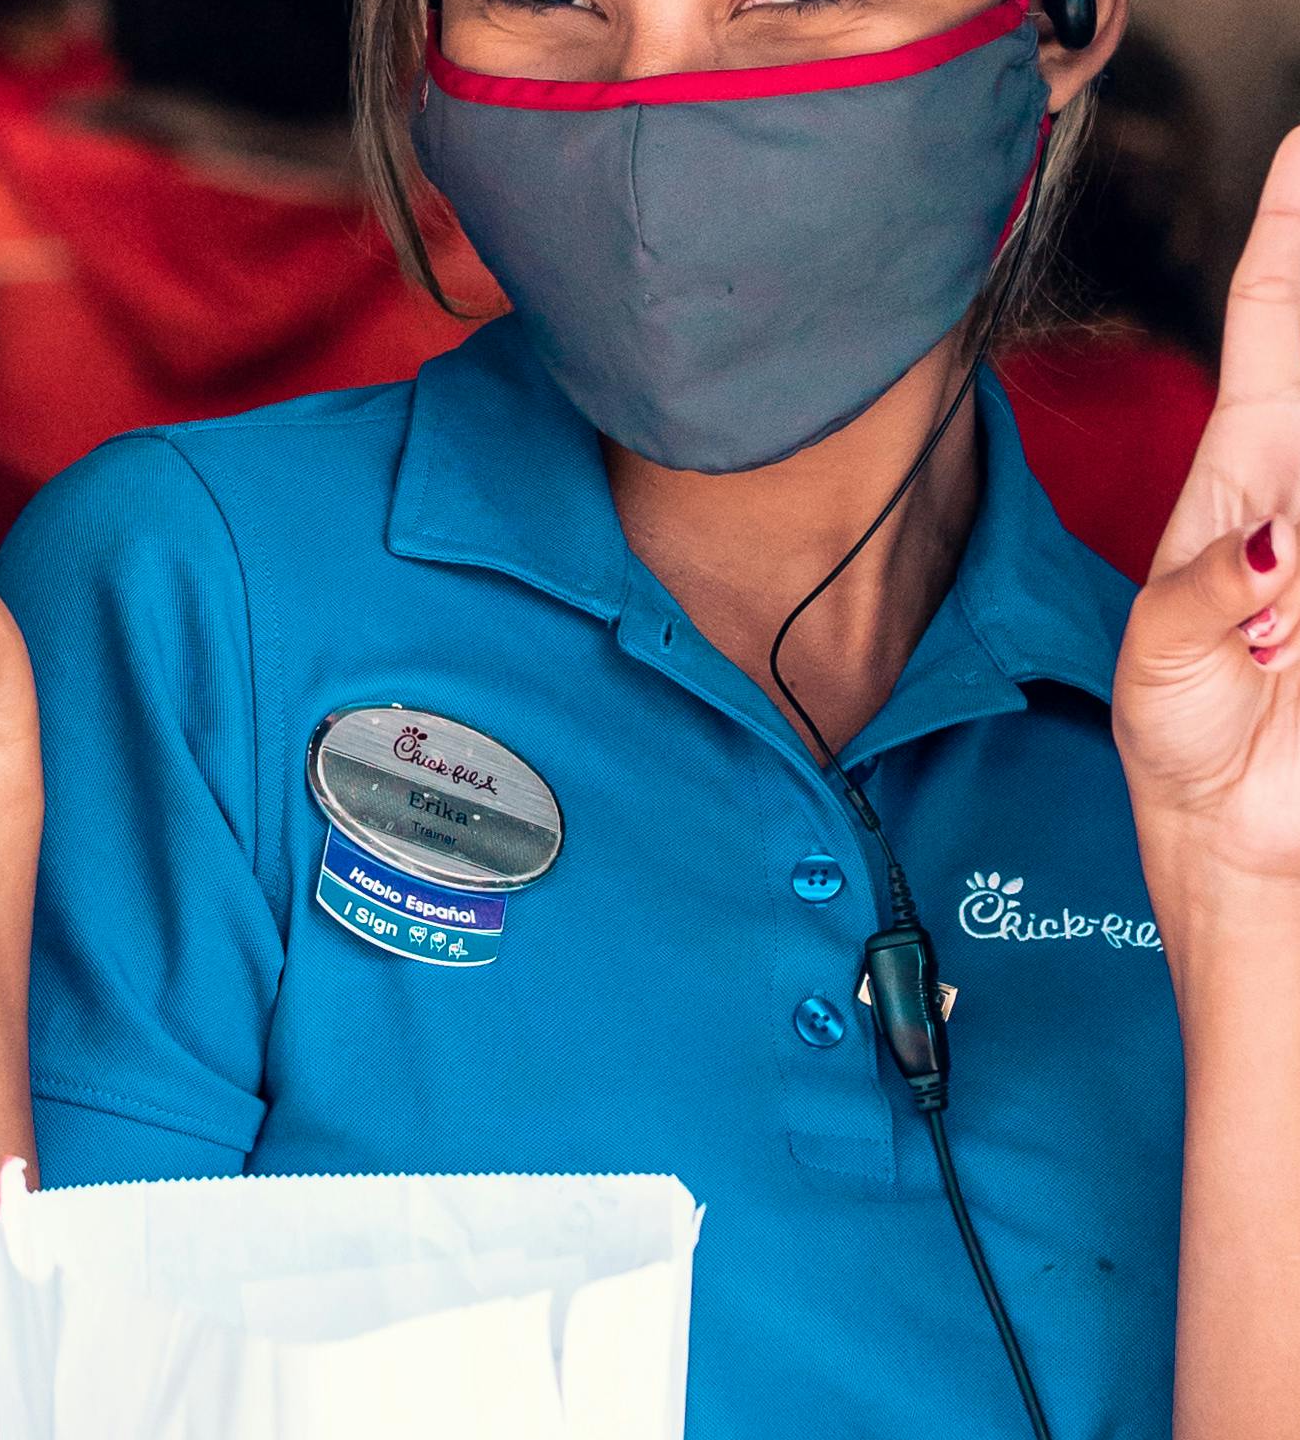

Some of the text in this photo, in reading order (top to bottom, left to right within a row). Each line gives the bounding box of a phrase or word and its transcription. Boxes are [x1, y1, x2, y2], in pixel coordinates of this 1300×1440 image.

[409, 790, 469, 827] Erika
[411, 820, 459, 848] Trainer
[349, 867, 476, 924] Hablo Español
[959, 872, 1165, 951] Chick-fil
[343, 901, 399, 937] I Sign
